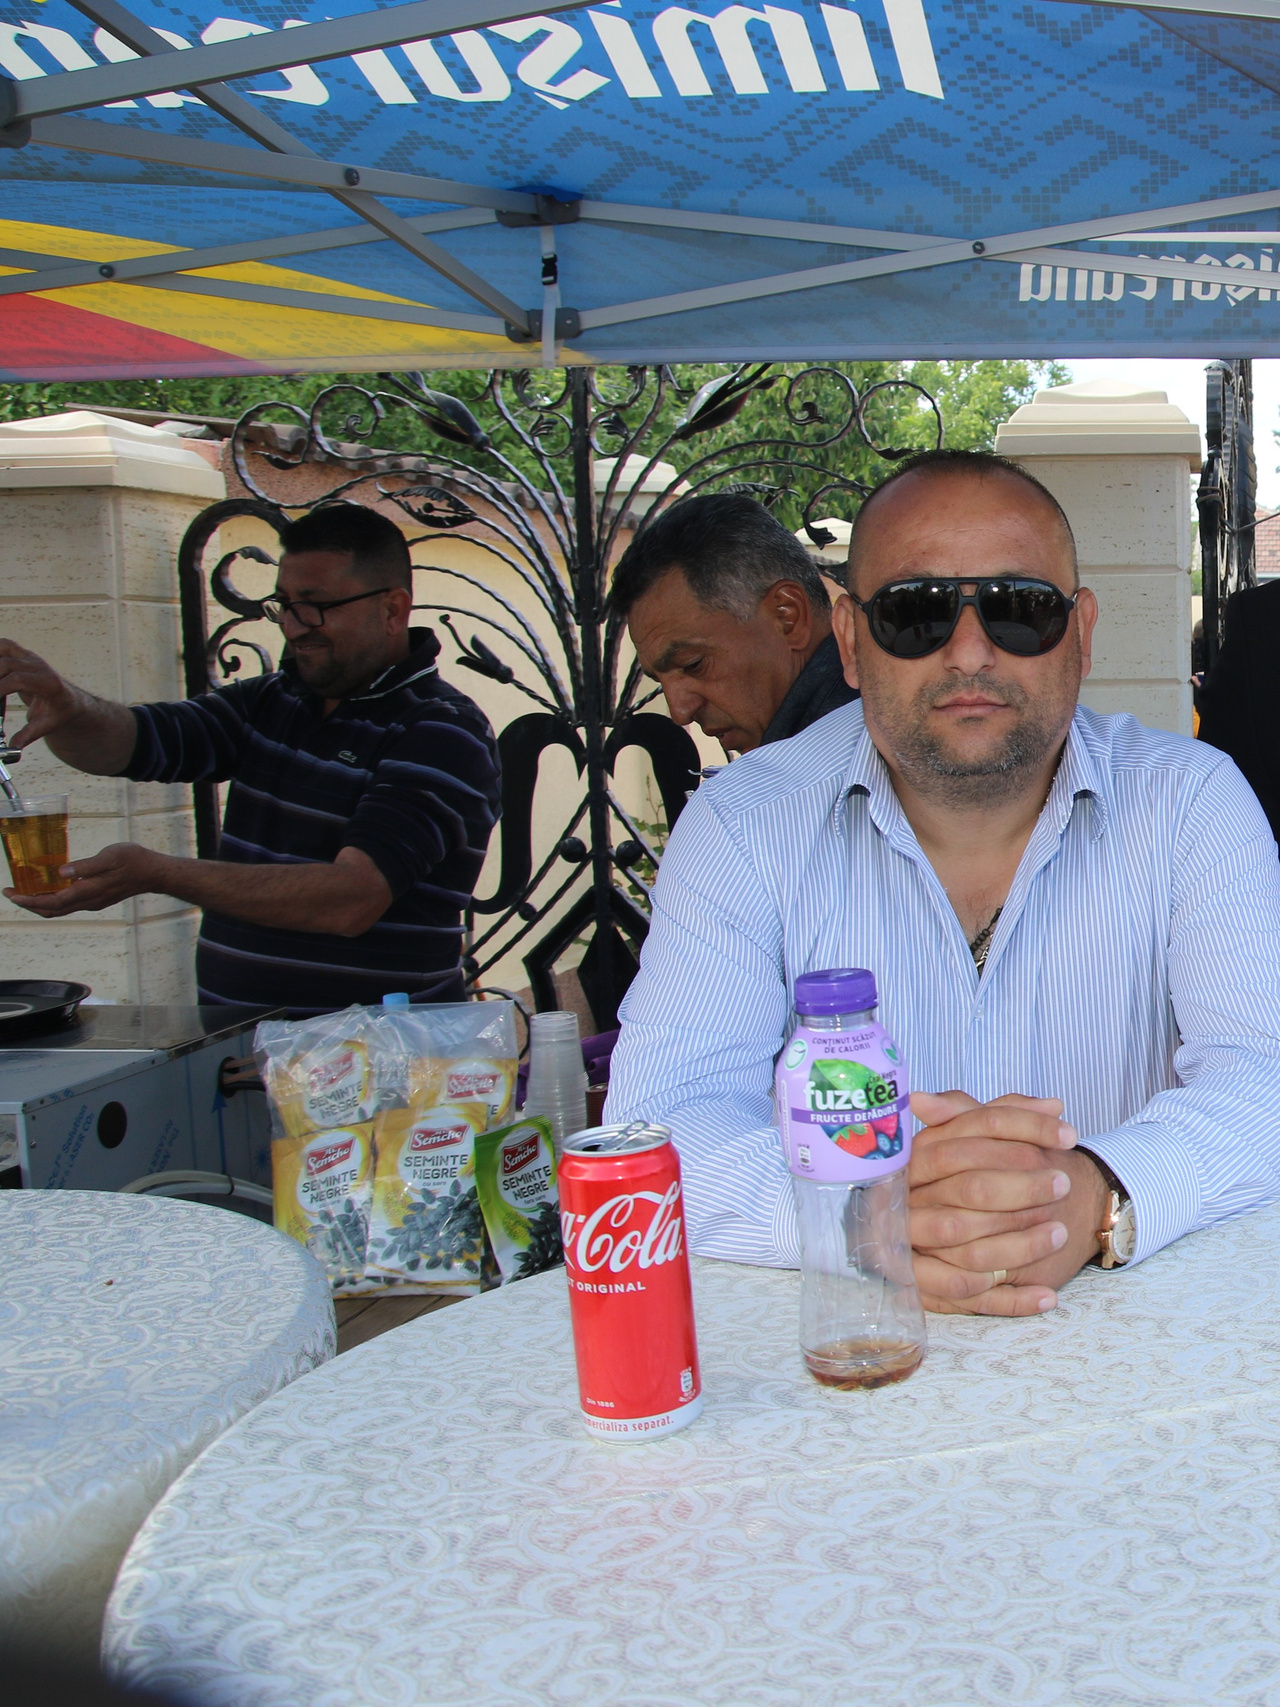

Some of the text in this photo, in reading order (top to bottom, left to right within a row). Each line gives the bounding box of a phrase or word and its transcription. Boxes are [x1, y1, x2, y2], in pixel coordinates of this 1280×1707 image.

[810, 1113, 851, 1123] FRUCTE
[412, 1130, 462, 1148] Semcho
[307, 1147, 349, 1172] Semcho
[404, 1154, 468, 1167] SEMINTE
[504, 1145, 537, 1170] Semcho
[302, 1169, 358, 1193] SEMINTE
[413, 1167, 458, 1179] NEGRE
[503, 1165, 552, 1190] SEMINTE
[310, 1184, 350, 1204] NEGRE
[513, 1180, 549, 1201] NEGRE
[577, 1281, 646, 1293] ORIGINAL
